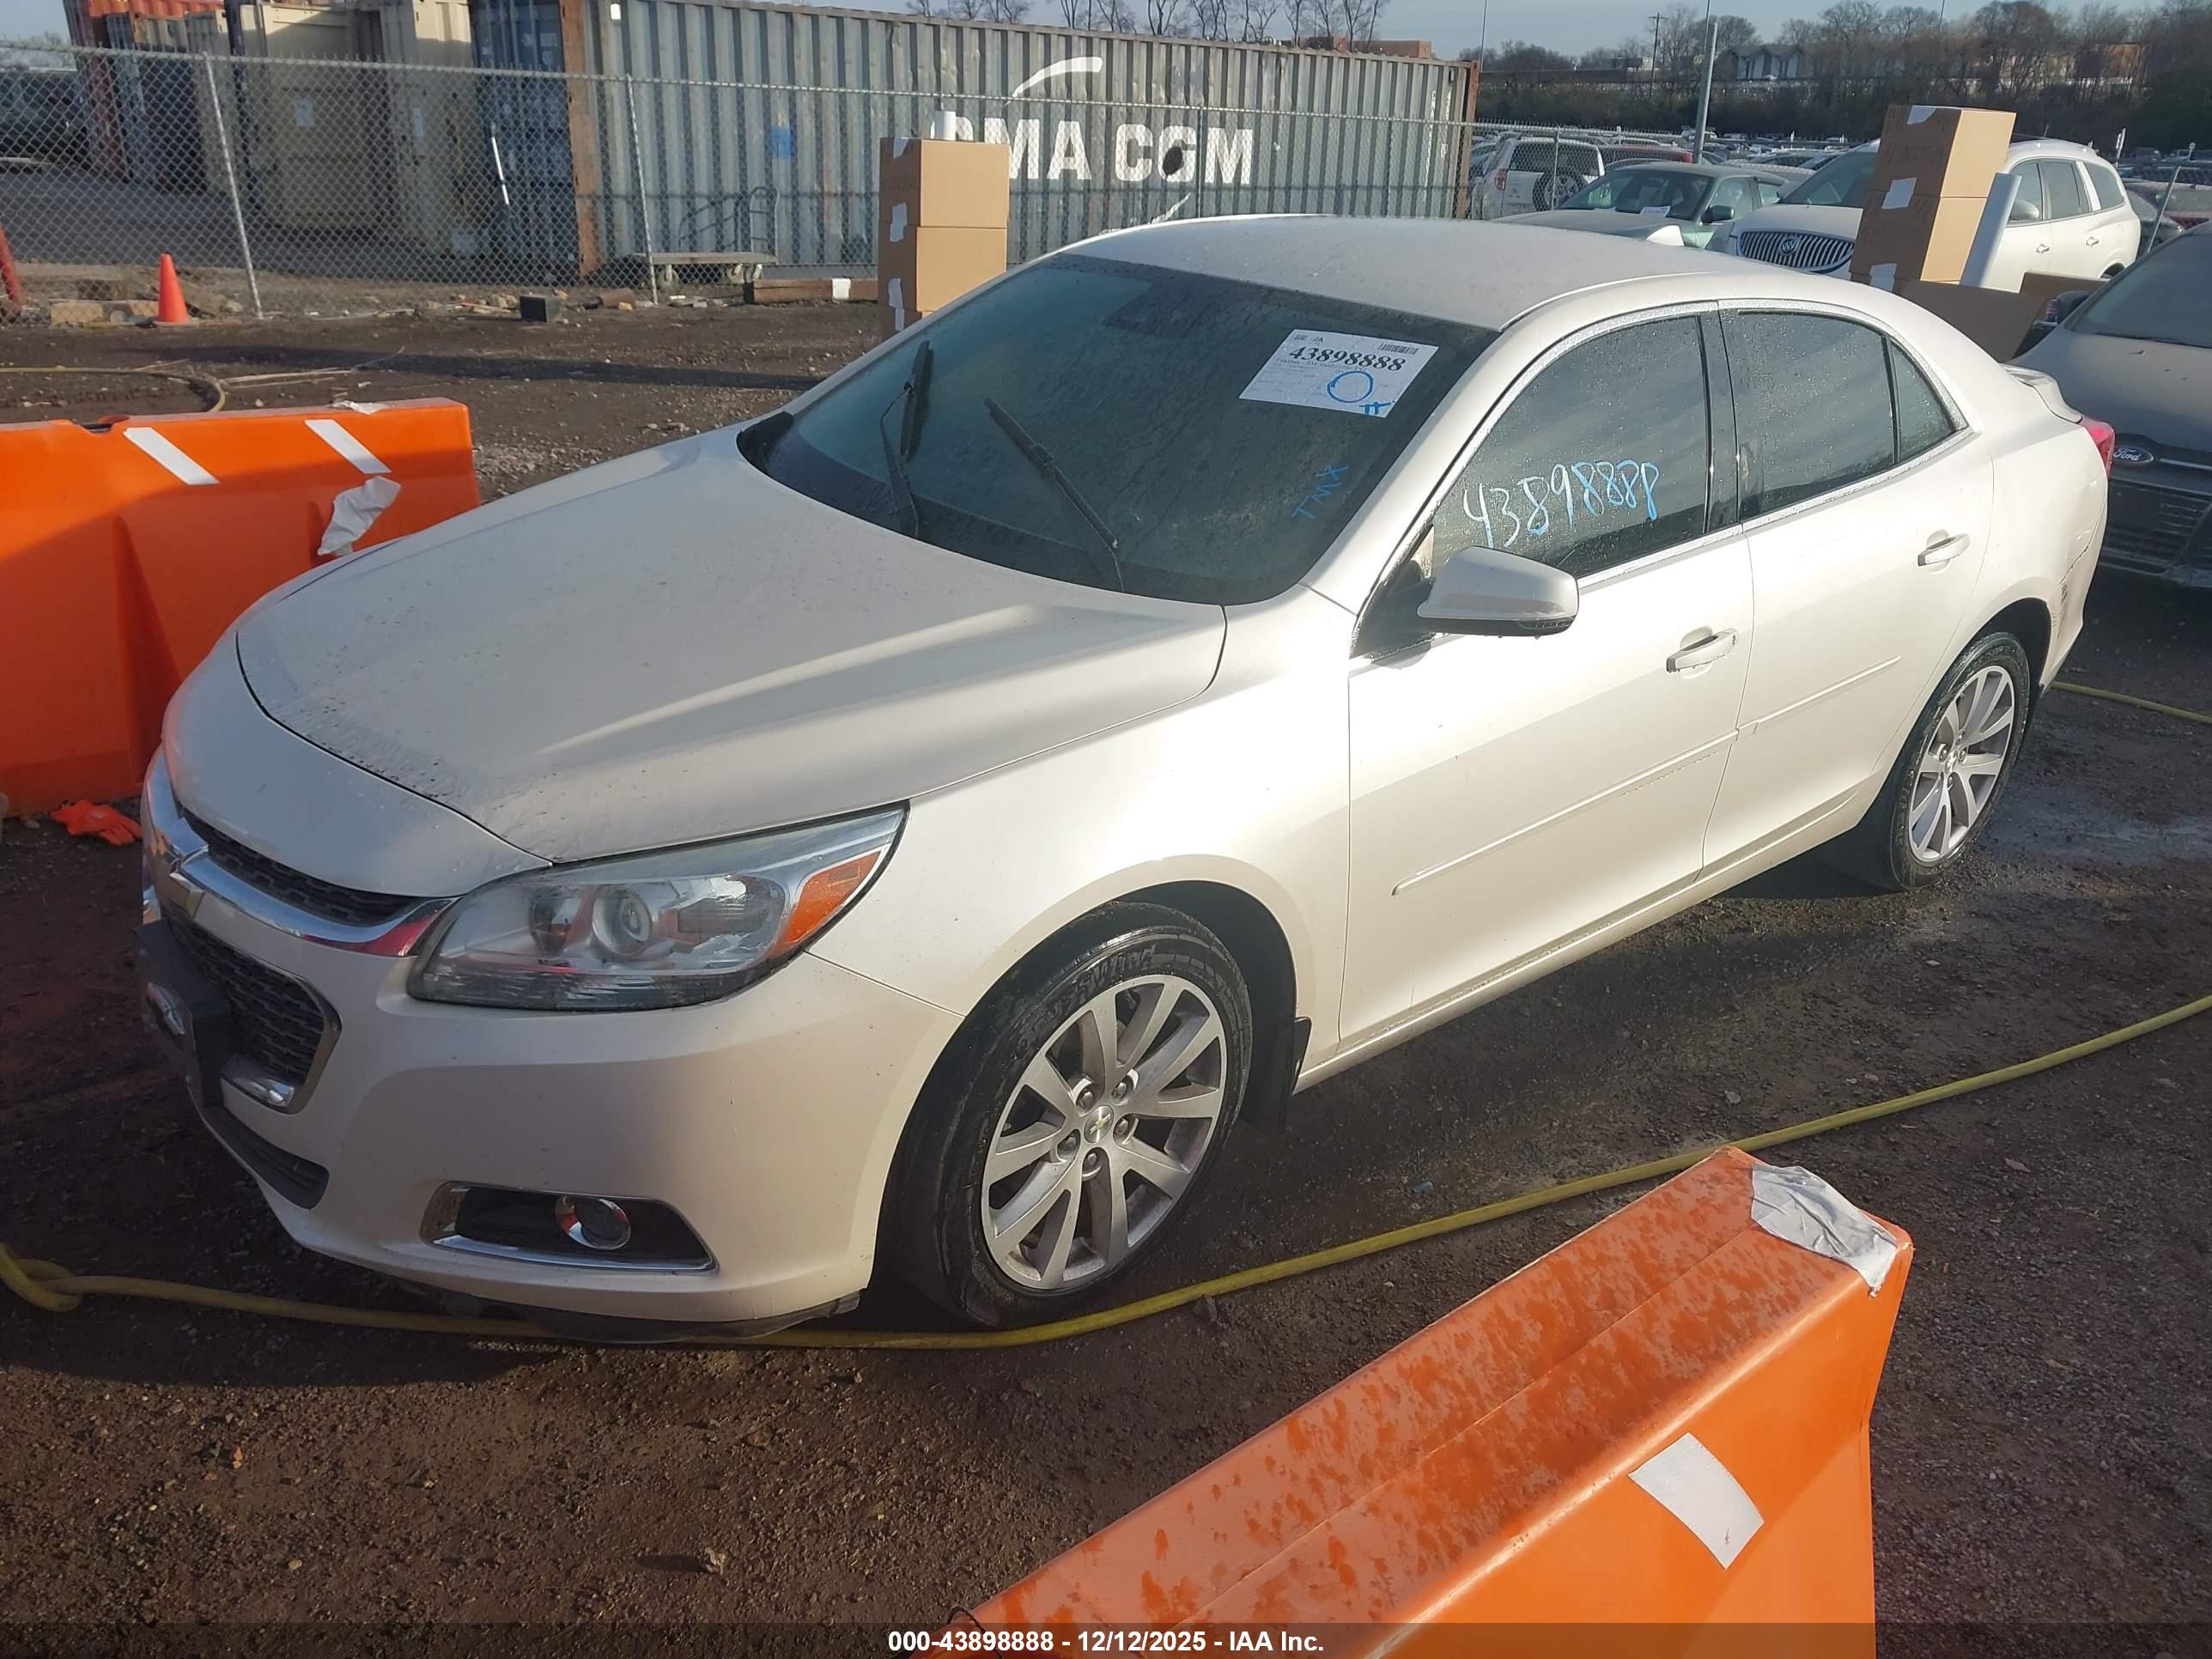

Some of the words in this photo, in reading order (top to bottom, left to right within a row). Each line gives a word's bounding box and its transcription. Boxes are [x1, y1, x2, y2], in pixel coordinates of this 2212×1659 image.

[930, 116, 1092, 179] MA
[1115, 124, 1253, 185] CGM
[1289, 346, 1407, 372] 43898888
[2113, 447, 2142, 461] Ford
[1462, 459, 1659, 549] 43898888
